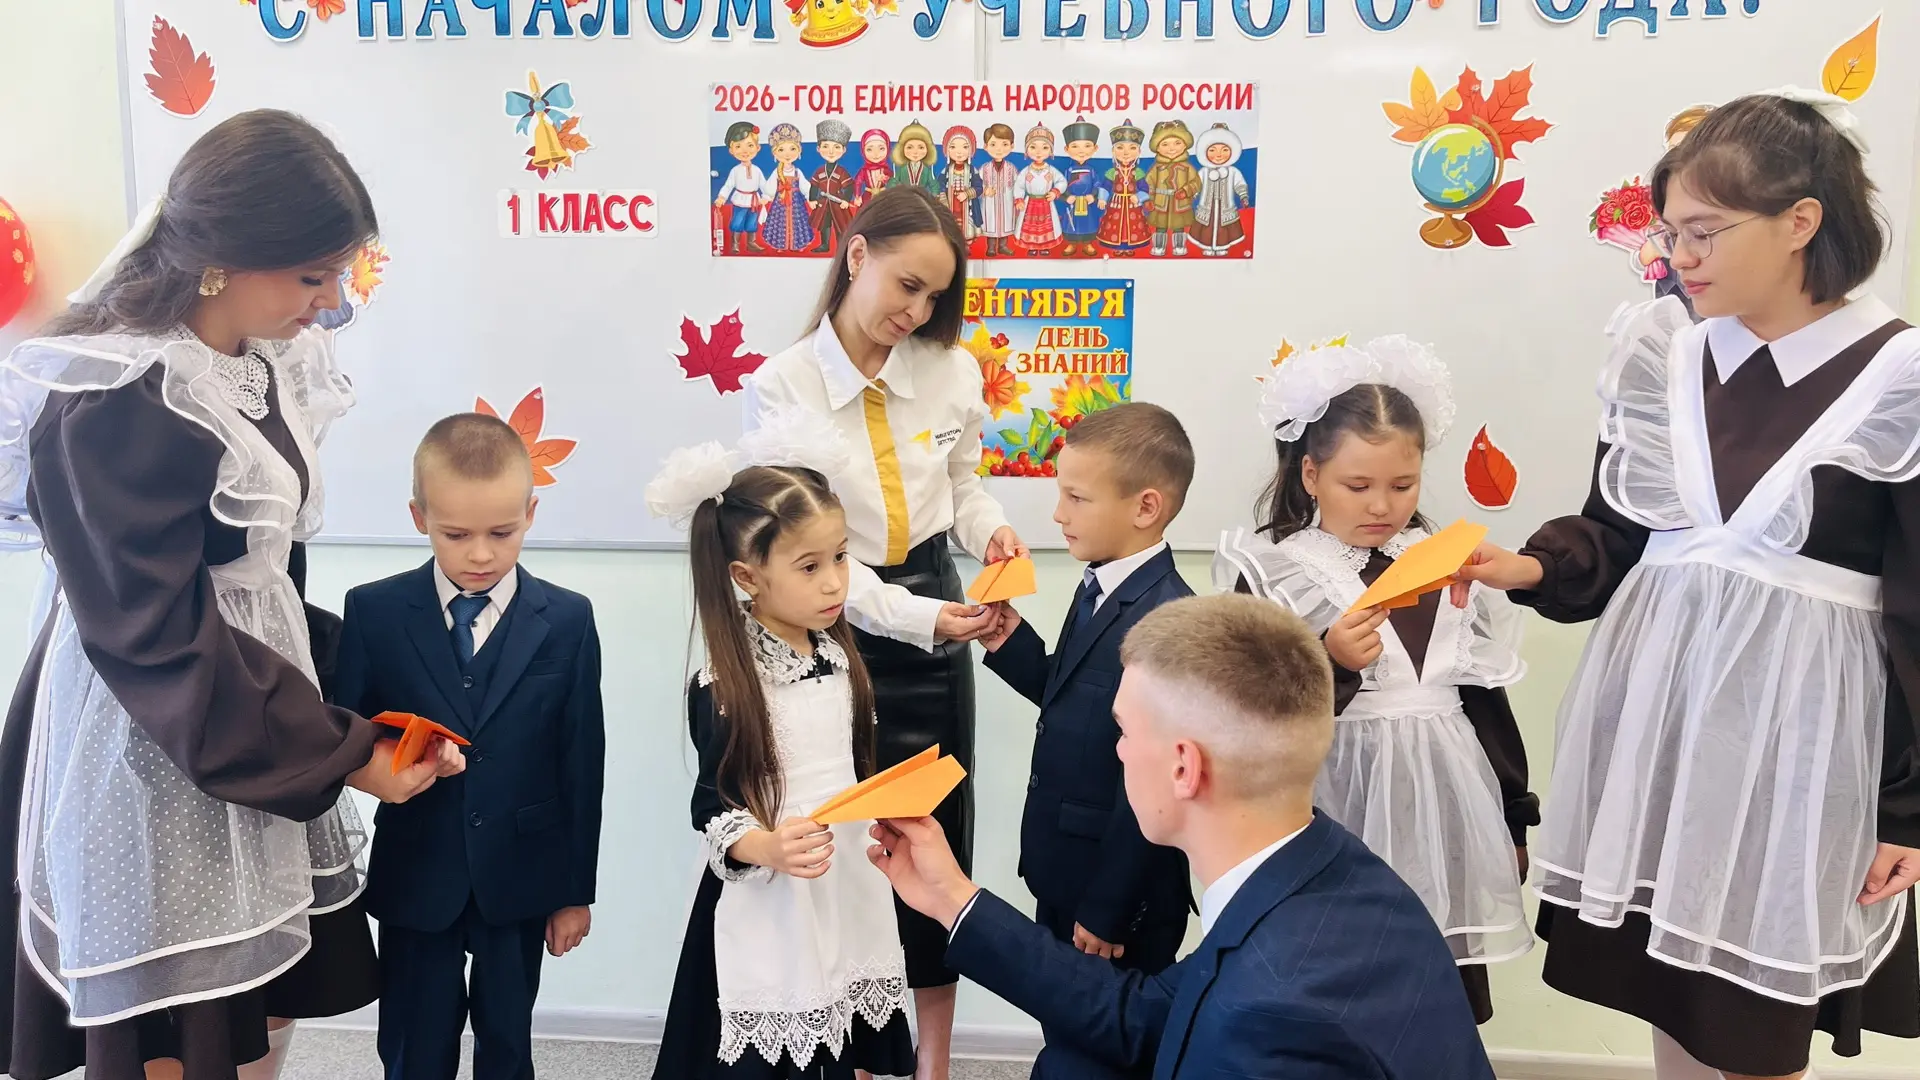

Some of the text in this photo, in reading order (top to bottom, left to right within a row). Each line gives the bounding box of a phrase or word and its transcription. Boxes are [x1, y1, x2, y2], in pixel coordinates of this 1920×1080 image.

[855, 84, 995, 115] ЕДИНСТВА
[1005, 83, 1131, 114] НАРОДОВ
[1142, 82, 1254, 112] РОССИИ
[507, 192, 655, 235] 1 КЛАСС
[962, 288, 1126, 319] ЕНТЯБРЯ
[1035, 326, 1109, 352] ДЕНЬ
[1015, 348, 1128, 375] ЗНАНИЙ
